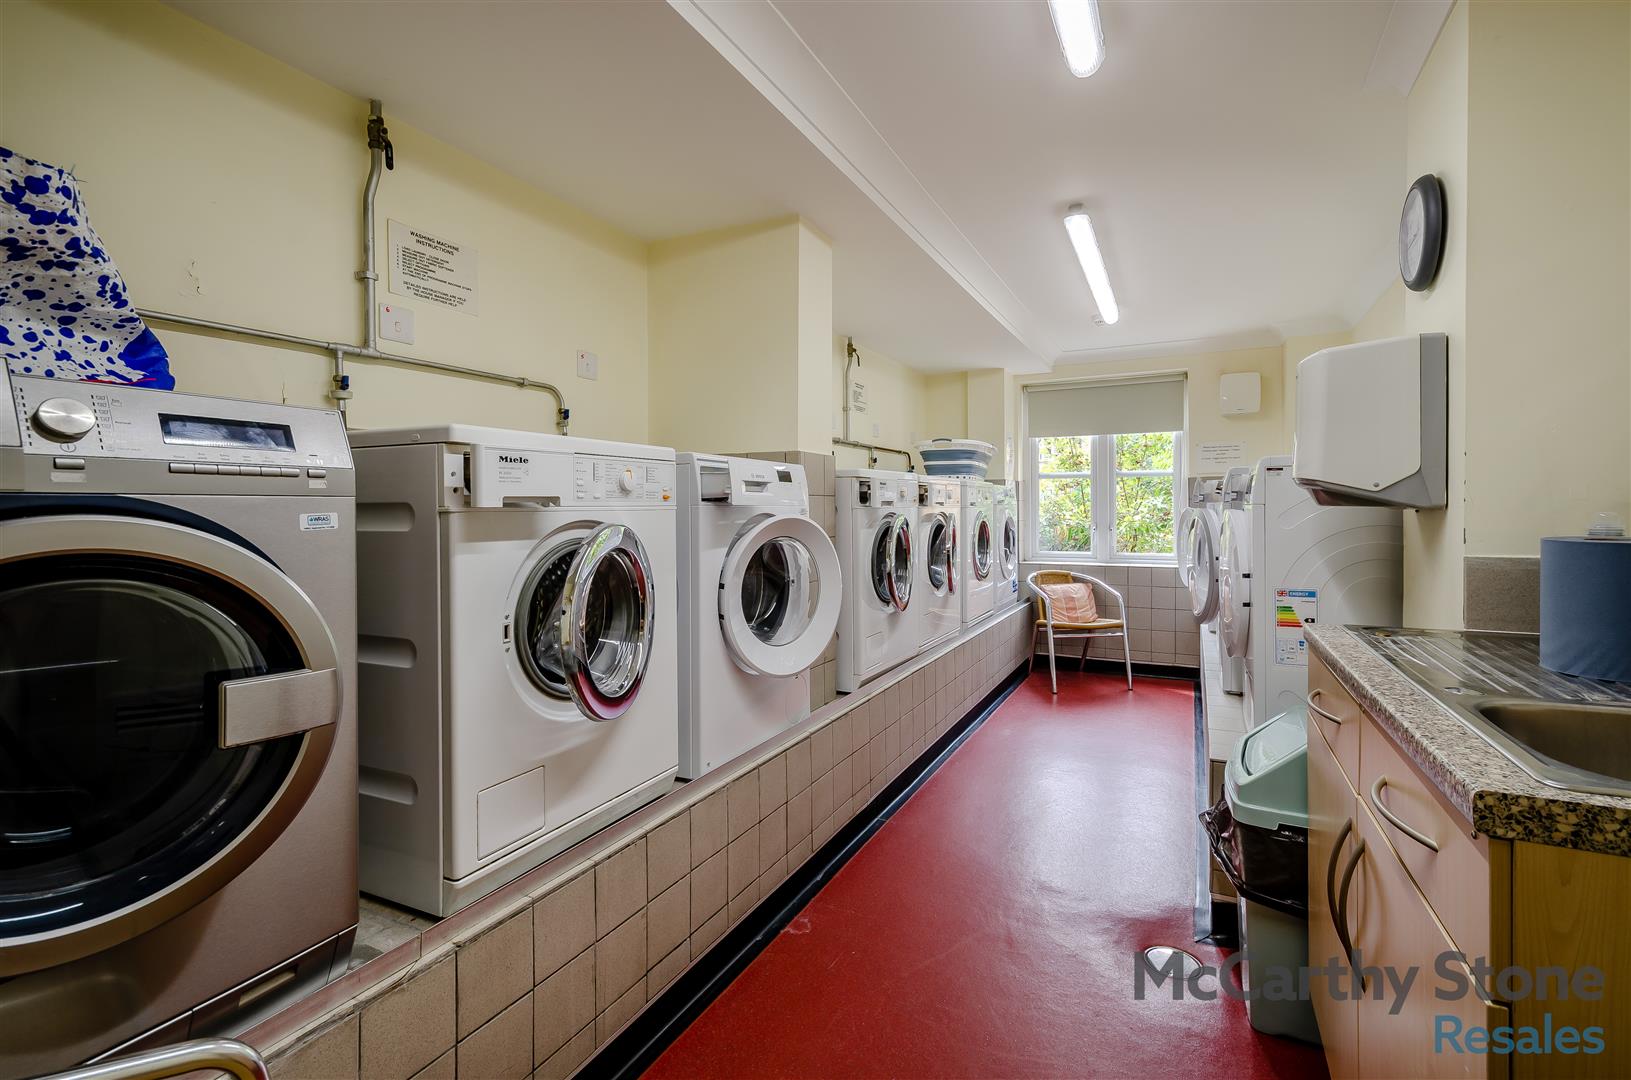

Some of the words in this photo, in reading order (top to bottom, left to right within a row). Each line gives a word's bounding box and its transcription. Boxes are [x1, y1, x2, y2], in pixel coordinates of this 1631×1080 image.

[410, 231, 435, 243] WASHING
[437, 240, 460, 252] MACHINE
[416, 239, 454, 255] INSTRUCTIONS
[499, 455, 529, 464] Miele
